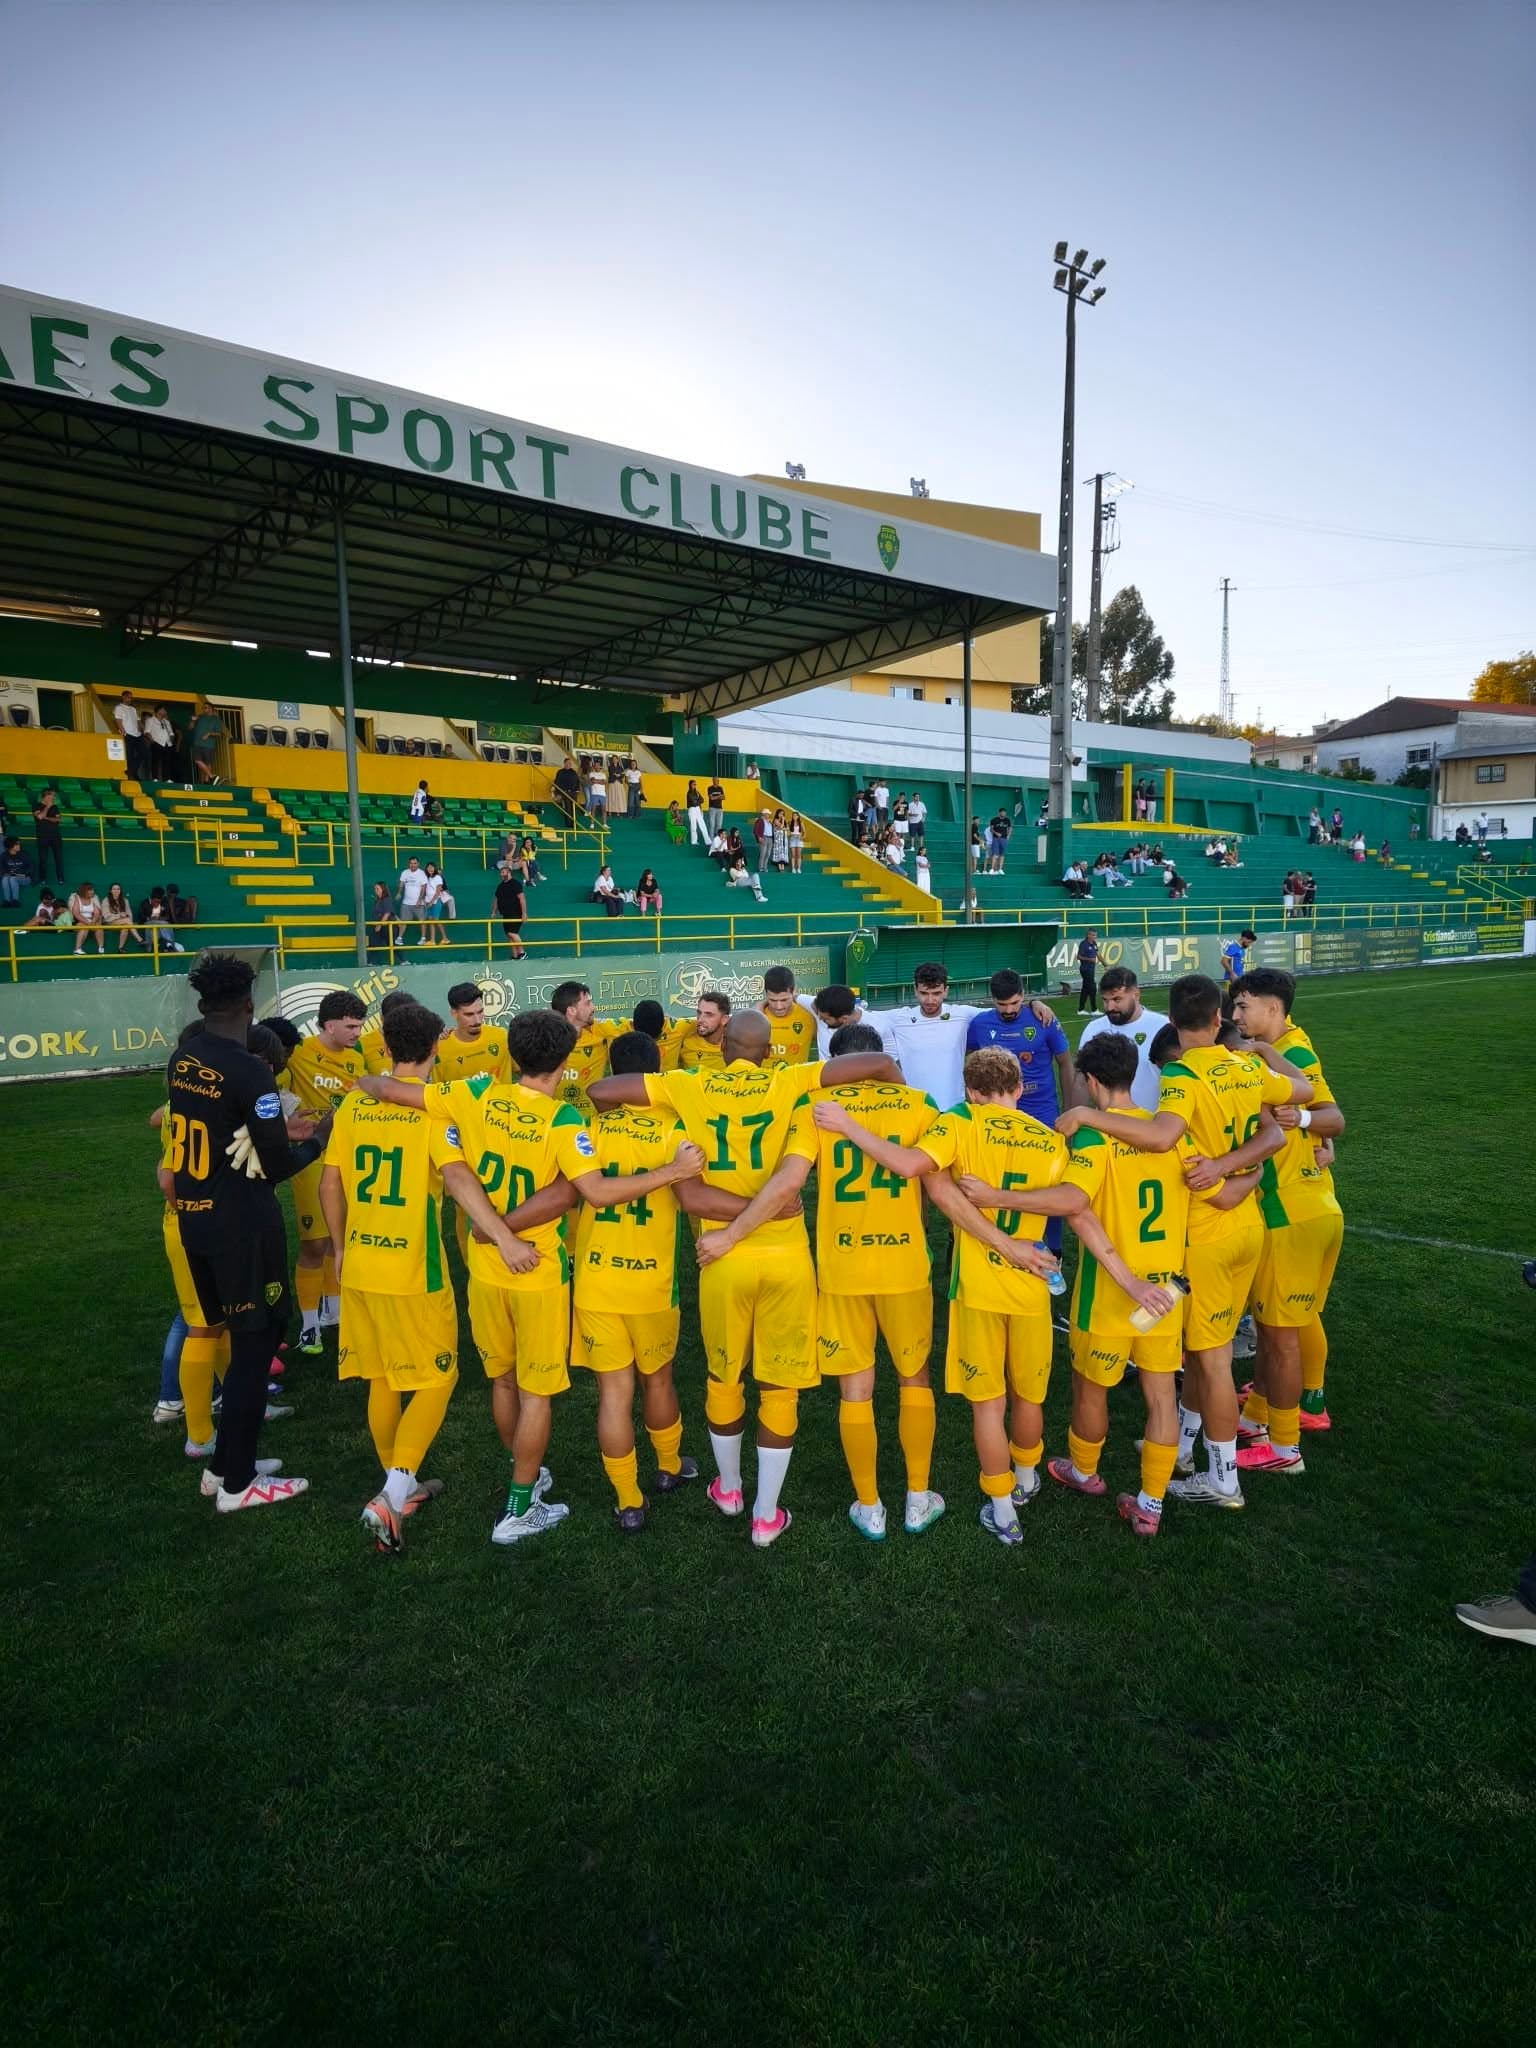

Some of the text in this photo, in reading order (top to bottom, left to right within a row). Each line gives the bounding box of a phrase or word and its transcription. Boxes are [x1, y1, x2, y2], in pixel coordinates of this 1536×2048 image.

[0, 314, 832, 561] ES SPORT CLUBE
[576, 732, 605, 748] ANS
[599, 977, 660, 999] PLACE
[0, 1026, 175, 1061] ORK, LDA.
[706, 1111, 774, 1171] 17
[355, 1144, 406, 1207] 21
[477, 1150, 536, 1215] 20
[833, 1135, 908, 1203] 24
[1138, 1179, 1166, 1243] 2
[361, 1234, 408, 1249] STAR
[861, 1232, 910, 1247] STAR
[611, 1256, 657, 1271] STAR
